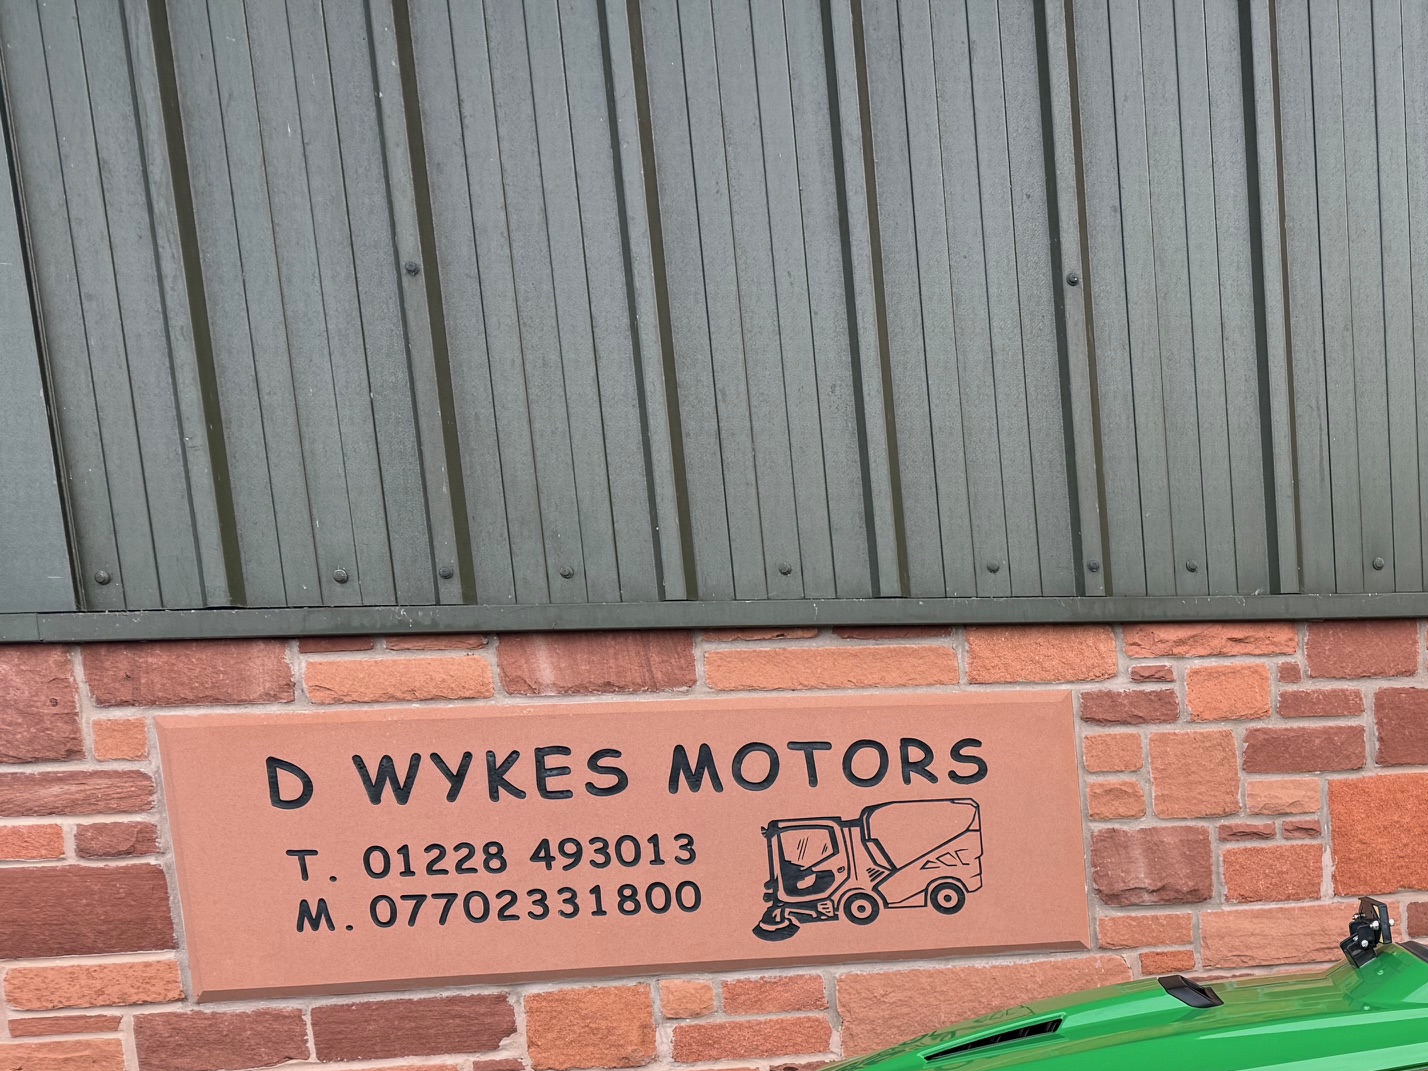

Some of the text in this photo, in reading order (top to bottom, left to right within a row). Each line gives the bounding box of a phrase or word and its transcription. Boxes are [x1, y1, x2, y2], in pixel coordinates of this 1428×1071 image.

[265, 737, 988, 810] D WYKES MOTORS
[285, 833, 697, 883] T. 01228 493013
[296, 880, 702, 933] M. 07702331800
